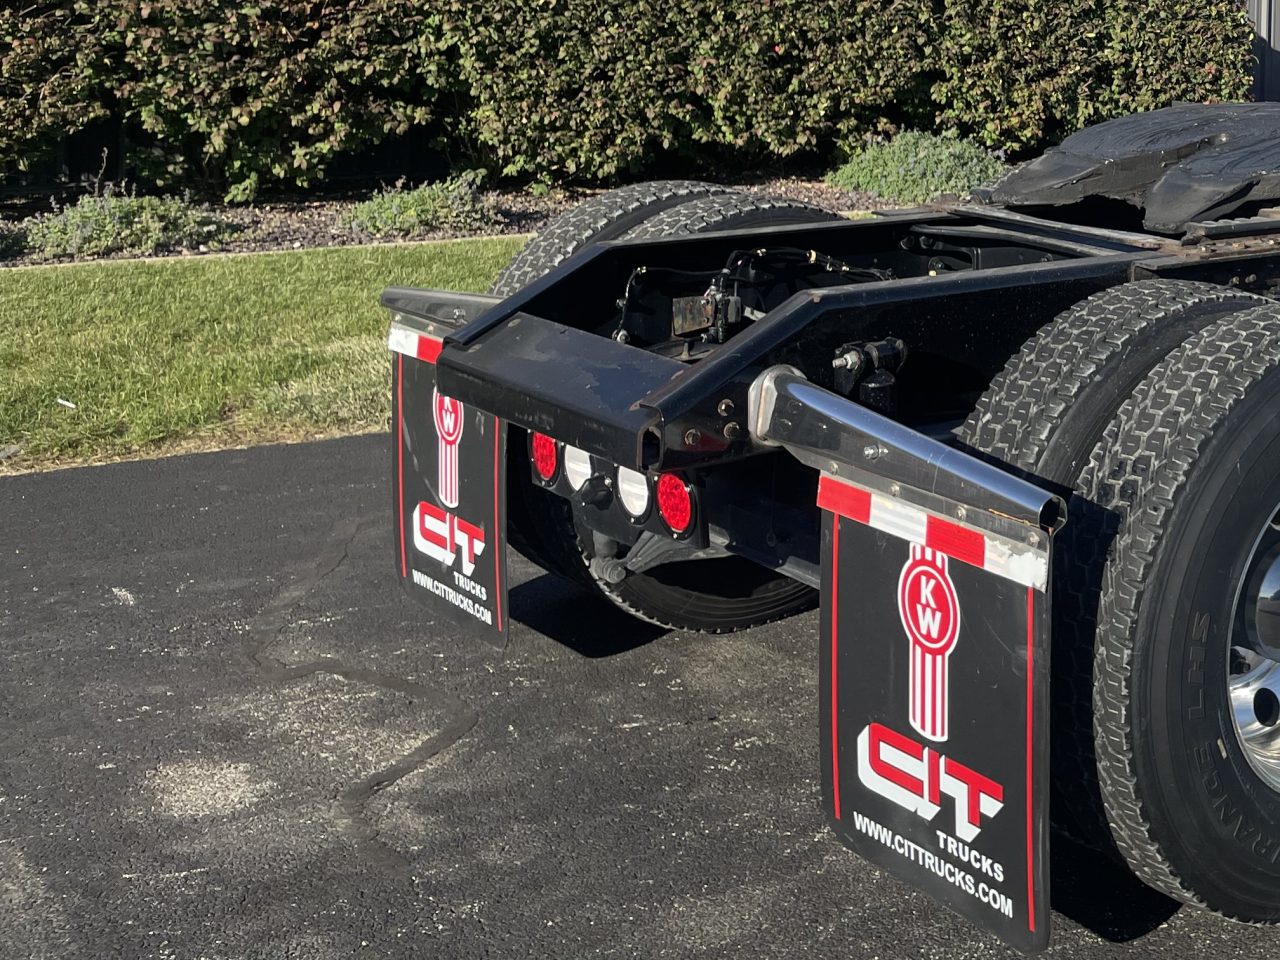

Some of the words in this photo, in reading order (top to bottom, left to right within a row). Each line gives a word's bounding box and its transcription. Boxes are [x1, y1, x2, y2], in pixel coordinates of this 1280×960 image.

[413, 500, 486, 578] CIT
[412, 569, 493, 626] WWW.CITTRUCKS.COM
[453, 571, 488, 601] TRUCKS
[857, 722, 1005, 843] CIT
[853, 811, 1014, 919] WWW.CITTRUCKS.COM
[937, 830, 1005, 883] TRUCKS
